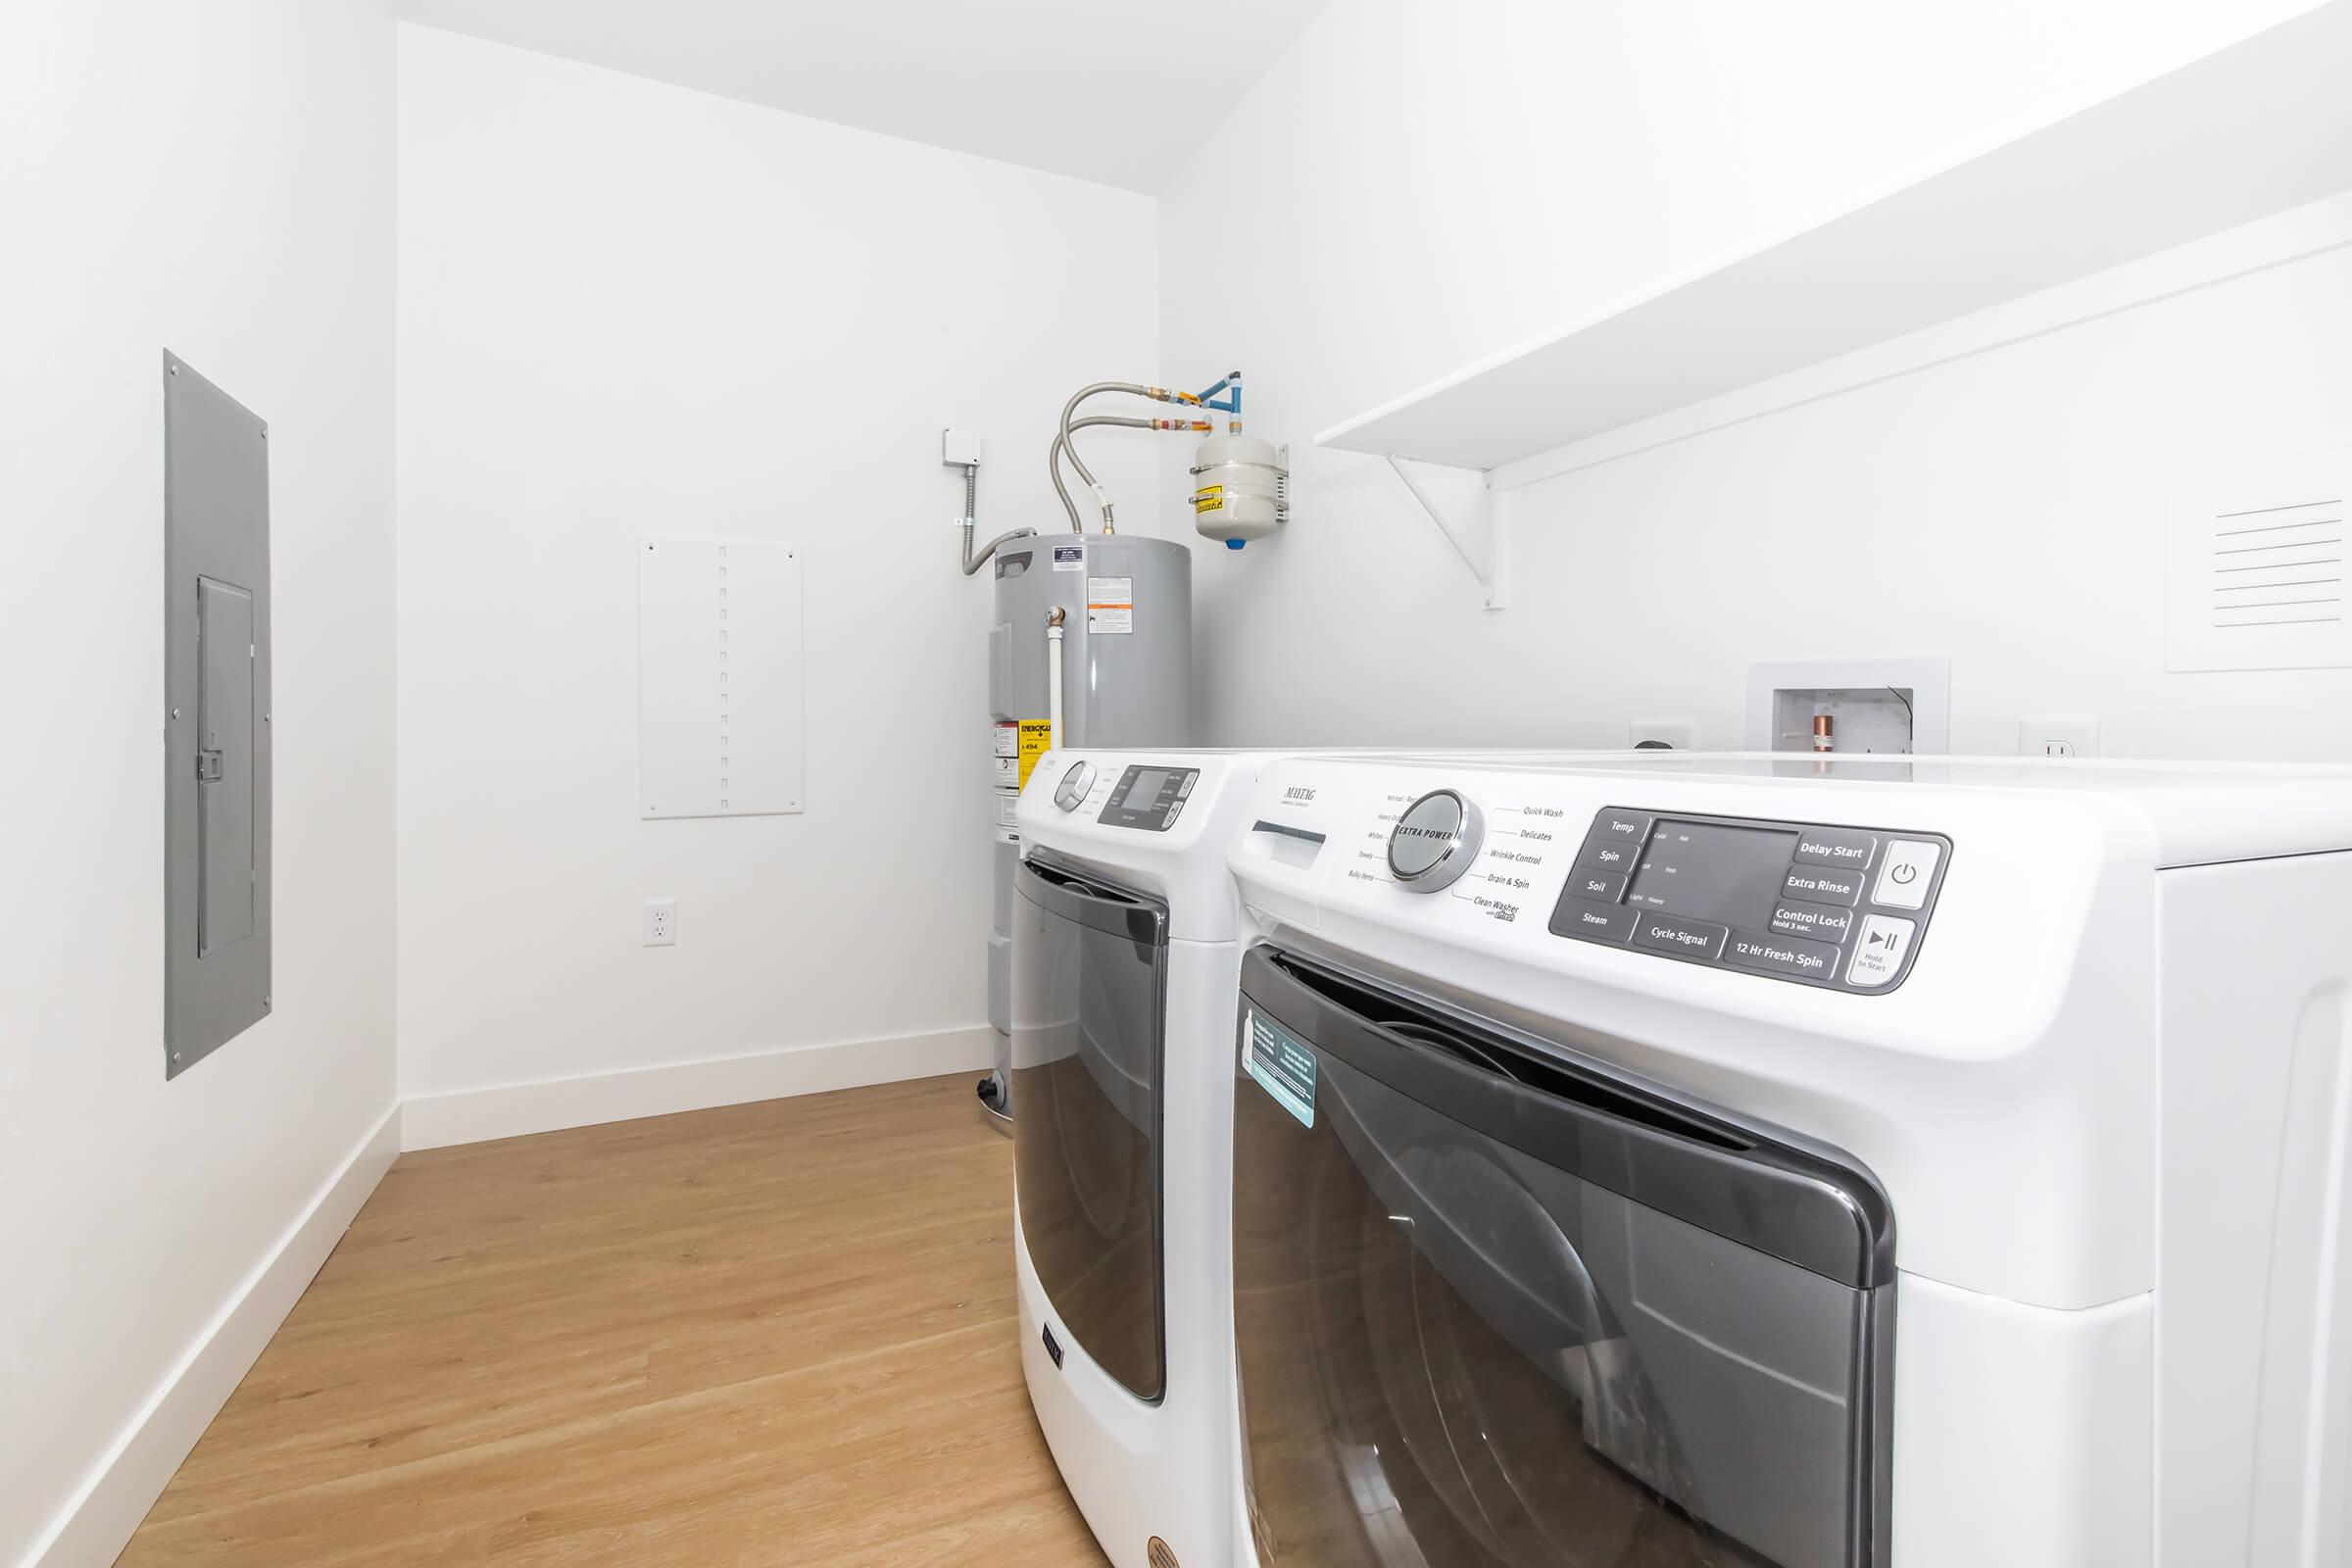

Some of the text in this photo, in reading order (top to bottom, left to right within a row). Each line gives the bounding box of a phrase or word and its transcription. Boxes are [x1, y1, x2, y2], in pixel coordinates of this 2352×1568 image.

[1284, 786, 1316, 801] MAYTAG
[1523, 807, 1563, 818] Quick Wash
[1398, 826, 1452, 841] EXTRA POWER
[1612, 821, 1635, 833] Temp
[1520, 829, 1552, 842] Delicates
[1490, 850, 1542, 865] Wrinkle Control
[1599, 850, 1620, 862] Spin
[1800, 843, 1863, 858] Delay Start
[1348, 869, 1362, 880] Bulky
[1488, 873, 1530, 890] Drain & Spin
[1587, 880, 1606, 893] Soil
[1788, 876, 1850, 894] Extra Rinse
[1630, 893, 1643, 902] Light
[1473, 896, 1519, 914] Clean Washer
[1582, 912, 1608, 925] Steam
[1776, 908, 1846, 929] Control Lock
[1772, 919, 1789, 928] Hold
[1796, 924, 1811, 933] sec.
[1651, 926, 1708, 947] Cycle Signal
[1736, 943, 1824, 969] 12 Hr Fresh Spin
[1864, 954, 1883, 963] Hold
[1867, 961, 1886, 972] Start
